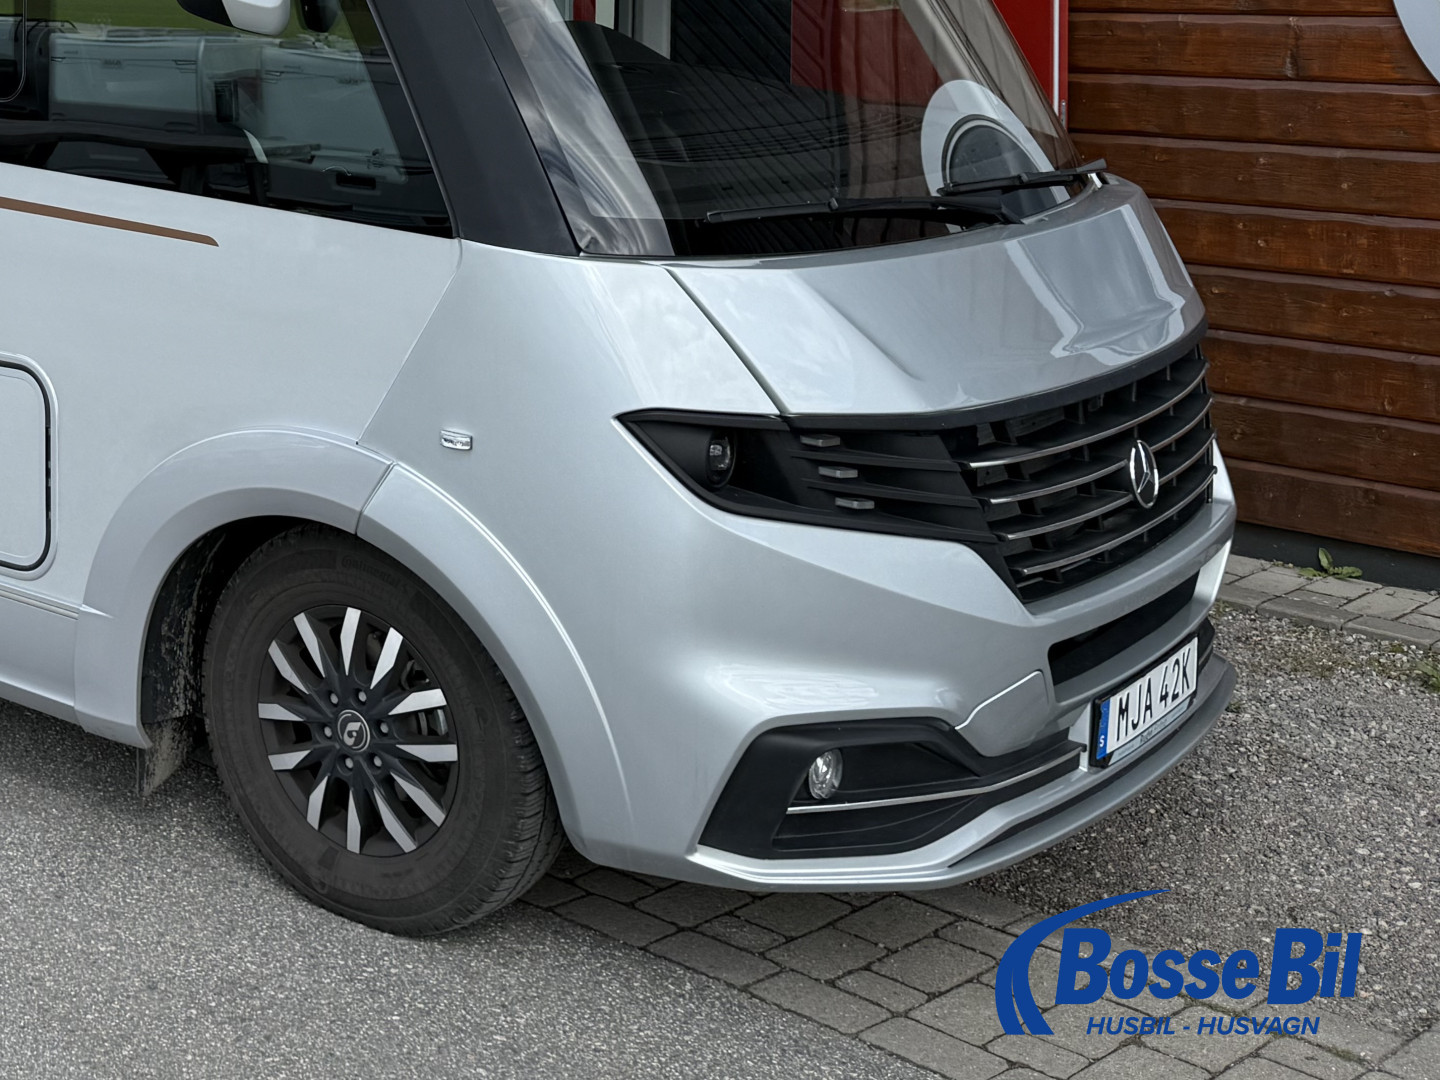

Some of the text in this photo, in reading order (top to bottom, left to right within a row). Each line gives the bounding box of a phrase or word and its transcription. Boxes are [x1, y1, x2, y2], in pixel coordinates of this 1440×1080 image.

[1116, 648, 1191, 742] MJA 42K
[1099, 735, 1106, 748] S
